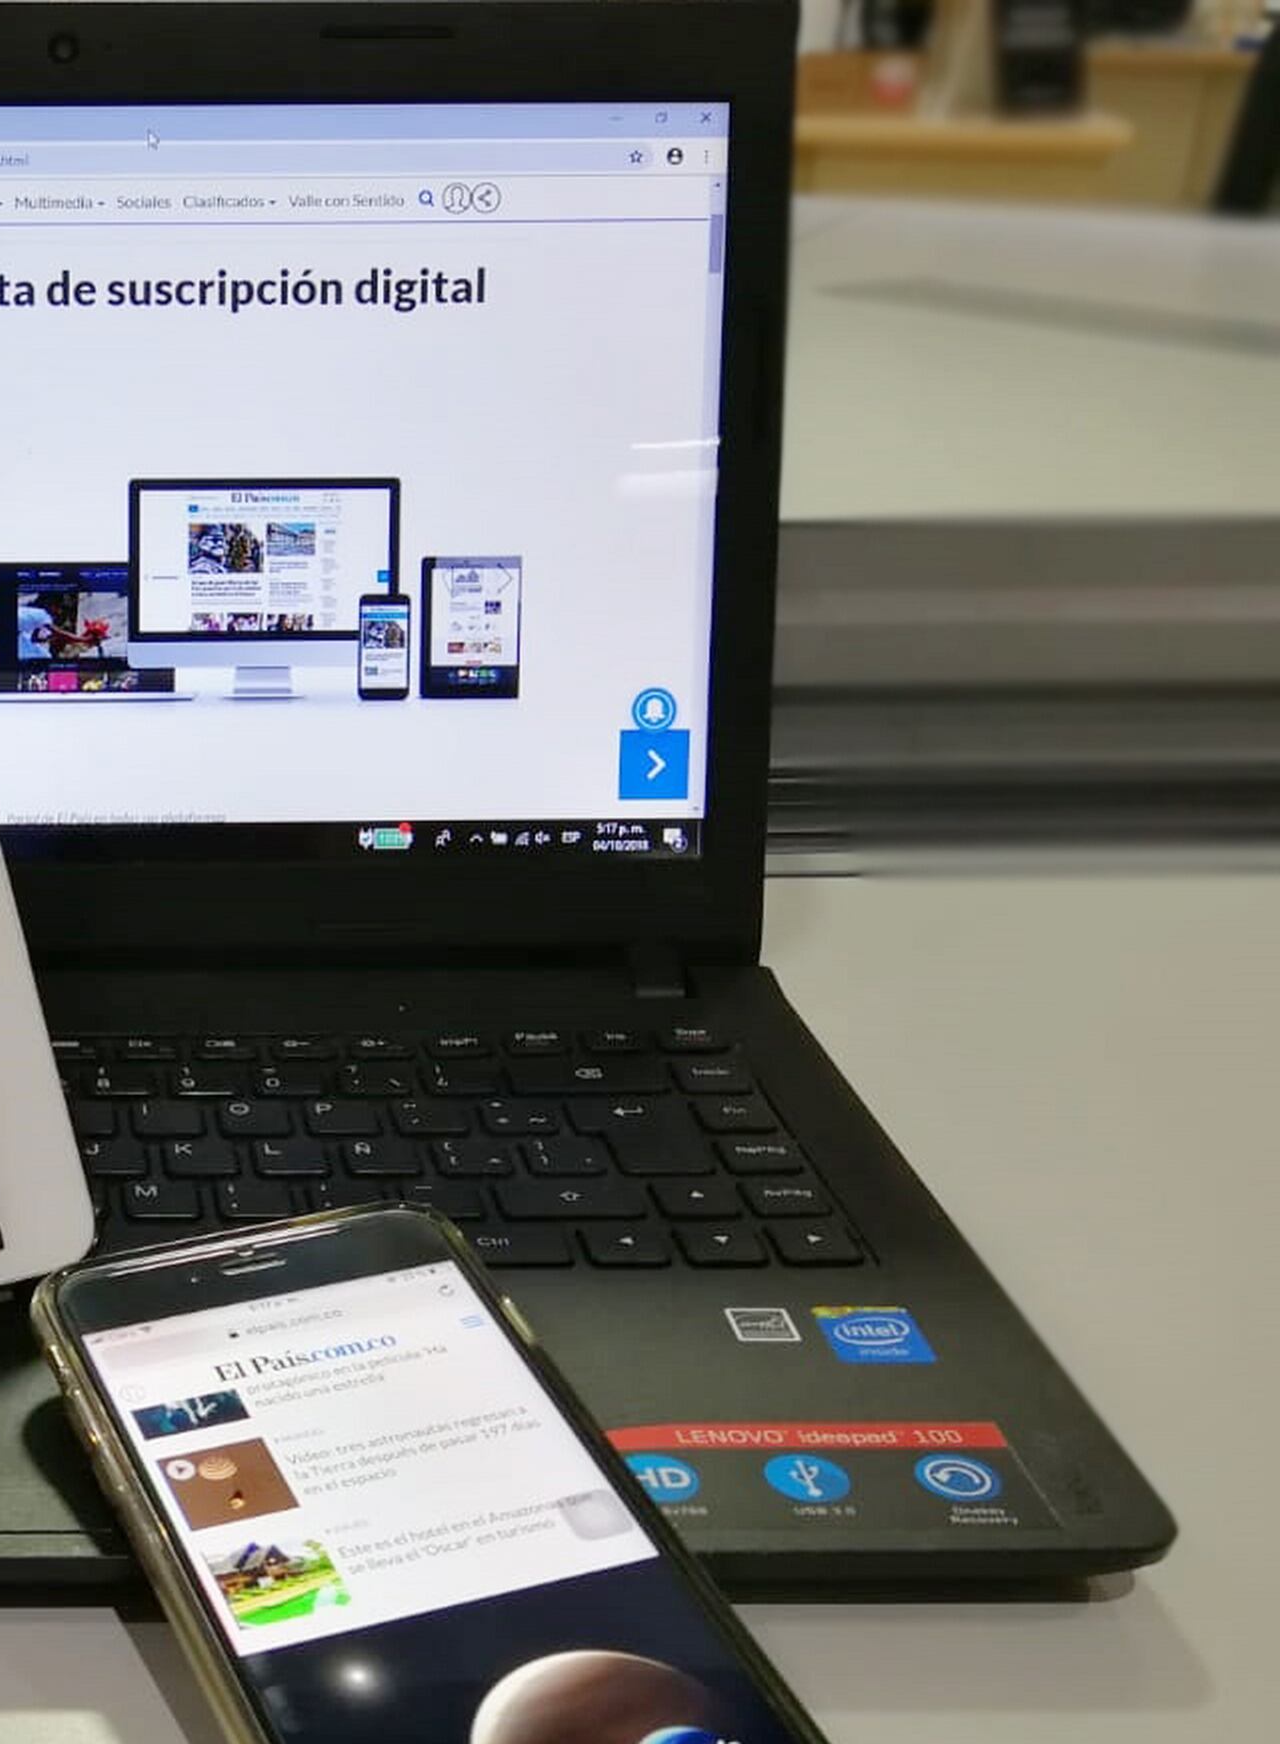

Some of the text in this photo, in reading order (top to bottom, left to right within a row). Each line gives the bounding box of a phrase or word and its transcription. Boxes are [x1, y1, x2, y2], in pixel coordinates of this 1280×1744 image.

[14, 195, 94, 210] Multimedia
[116, 195, 171, 210] Sociales
[182, 194, 265, 209] Clasificados
[288, 193, 322, 208] Valle
[324, 197, 350, 208] con
[351, 193, 405, 208] Sentido
[46, 270, 98, 307] de
[106, 268, 344, 314] suscripción
[353, 266, 486, 313] digital
[314, 1102, 333, 1115] P
[85, 1142, 100, 1156] J
[174, 1142, 193, 1156] K
[264, 1142, 283, 1156] L
[134, 1185, 159, 1199] M
[213, 1361, 247, 1383] El
[303, 1384, 332, 1399] una
[334, 1442, 366, 1456] tres
[367, 1421, 454, 1450] astronautas
[453, 1408, 519, 1432] regresan
[675, 1429, 964, 1448] LENOVO ideapad 100
[311, 1424, 509, 1478] Tierra después de pasar 197
[302, 1467, 399, 1497] en el espacio
[336, 1542, 374, 1561] Este
[409, 1522, 451, 1545] hotel
[451, 1520, 472, 1535] en
[348, 1518, 557, 1577] se lleva en turismo
